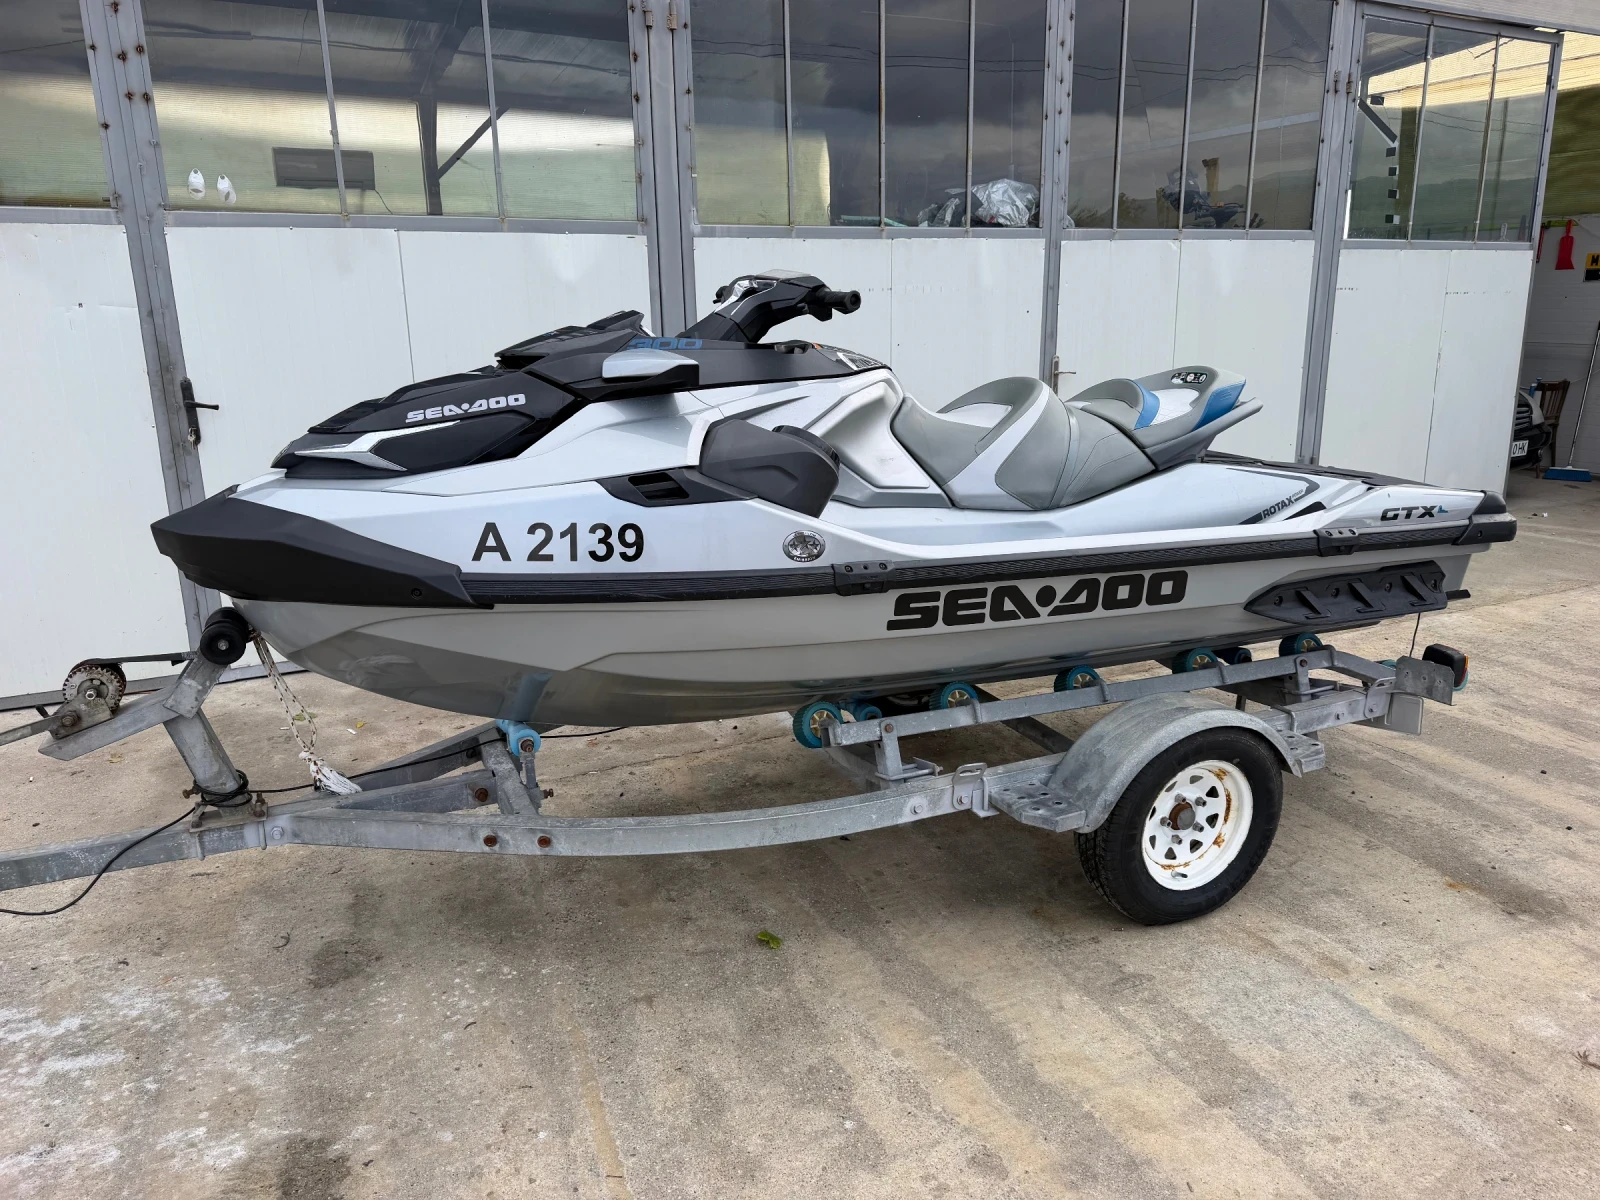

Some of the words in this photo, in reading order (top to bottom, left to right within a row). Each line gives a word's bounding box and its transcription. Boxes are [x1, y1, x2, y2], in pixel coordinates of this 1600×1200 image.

[1262, 496, 1295, 519] ROTAX
[1380, 505, 1438, 521] GTX
[471, 522, 512, 561] A
[526, 522, 644, 562] 2139
